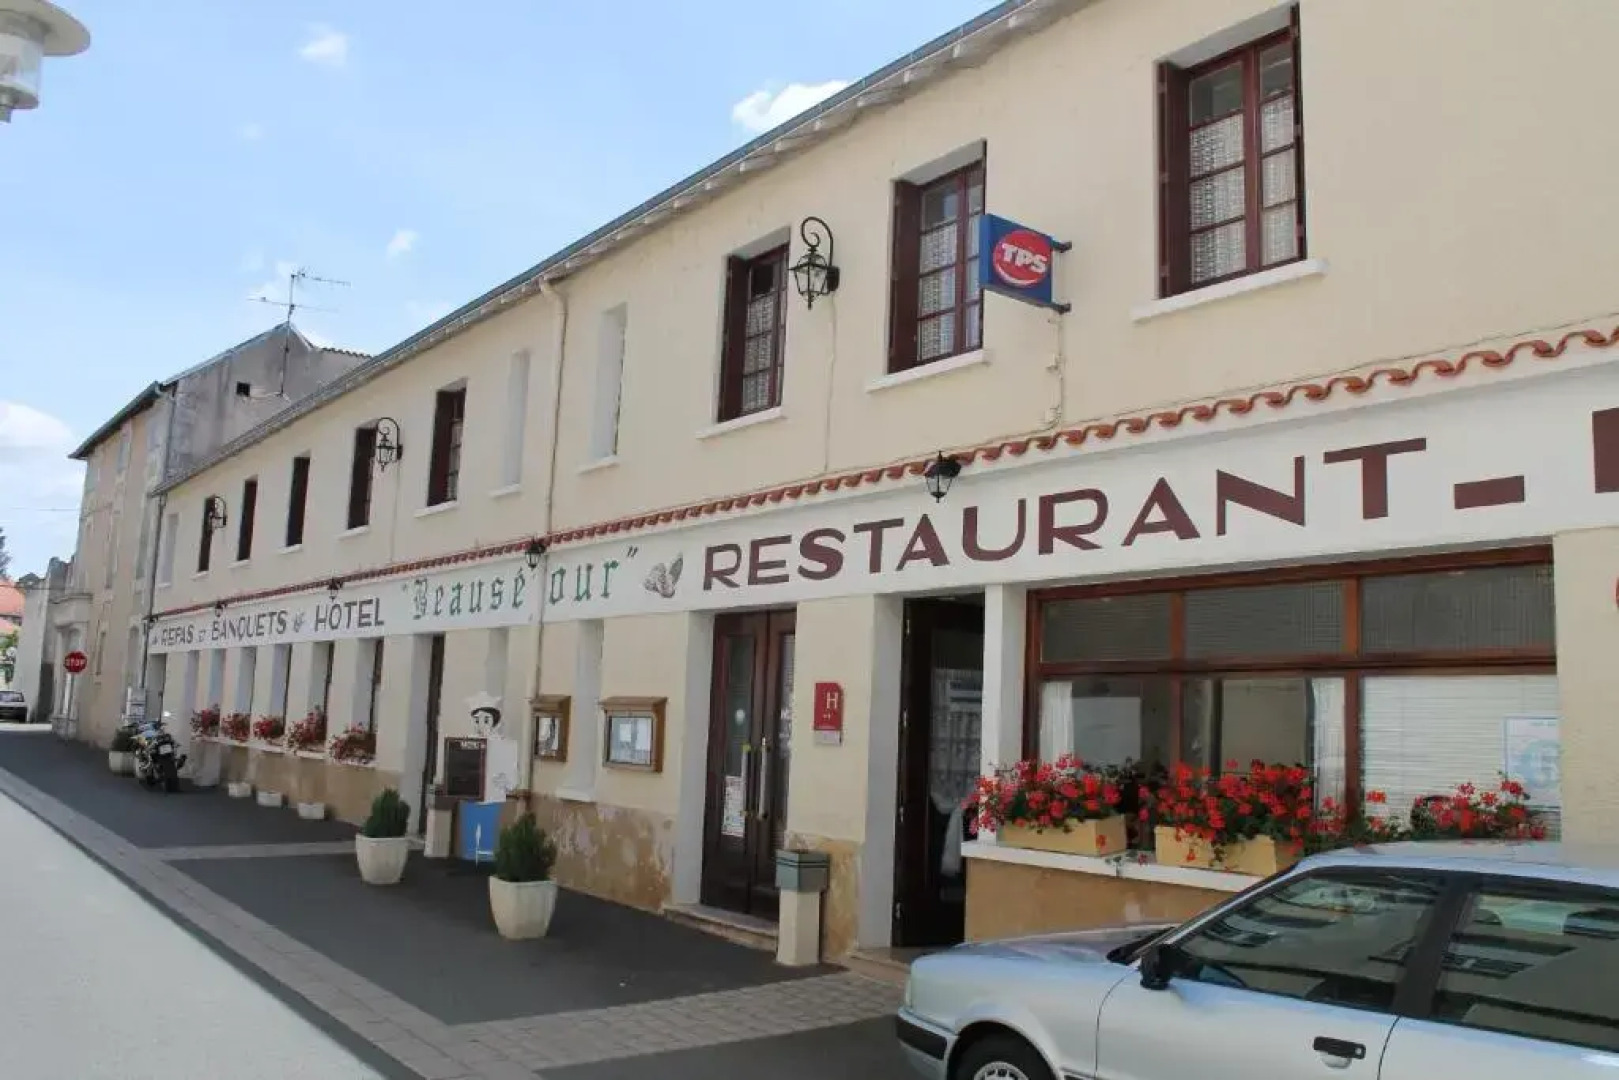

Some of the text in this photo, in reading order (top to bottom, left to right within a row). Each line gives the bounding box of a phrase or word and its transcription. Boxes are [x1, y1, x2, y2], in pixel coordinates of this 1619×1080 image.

[1002, 242, 1047, 273] TPS
[211, 610, 288, 641] BANQUETS
[702, 437, 1426, 592] RESTAURANT
[65, 657, 87, 667] STOP
[826, 692, 839, 709] H
